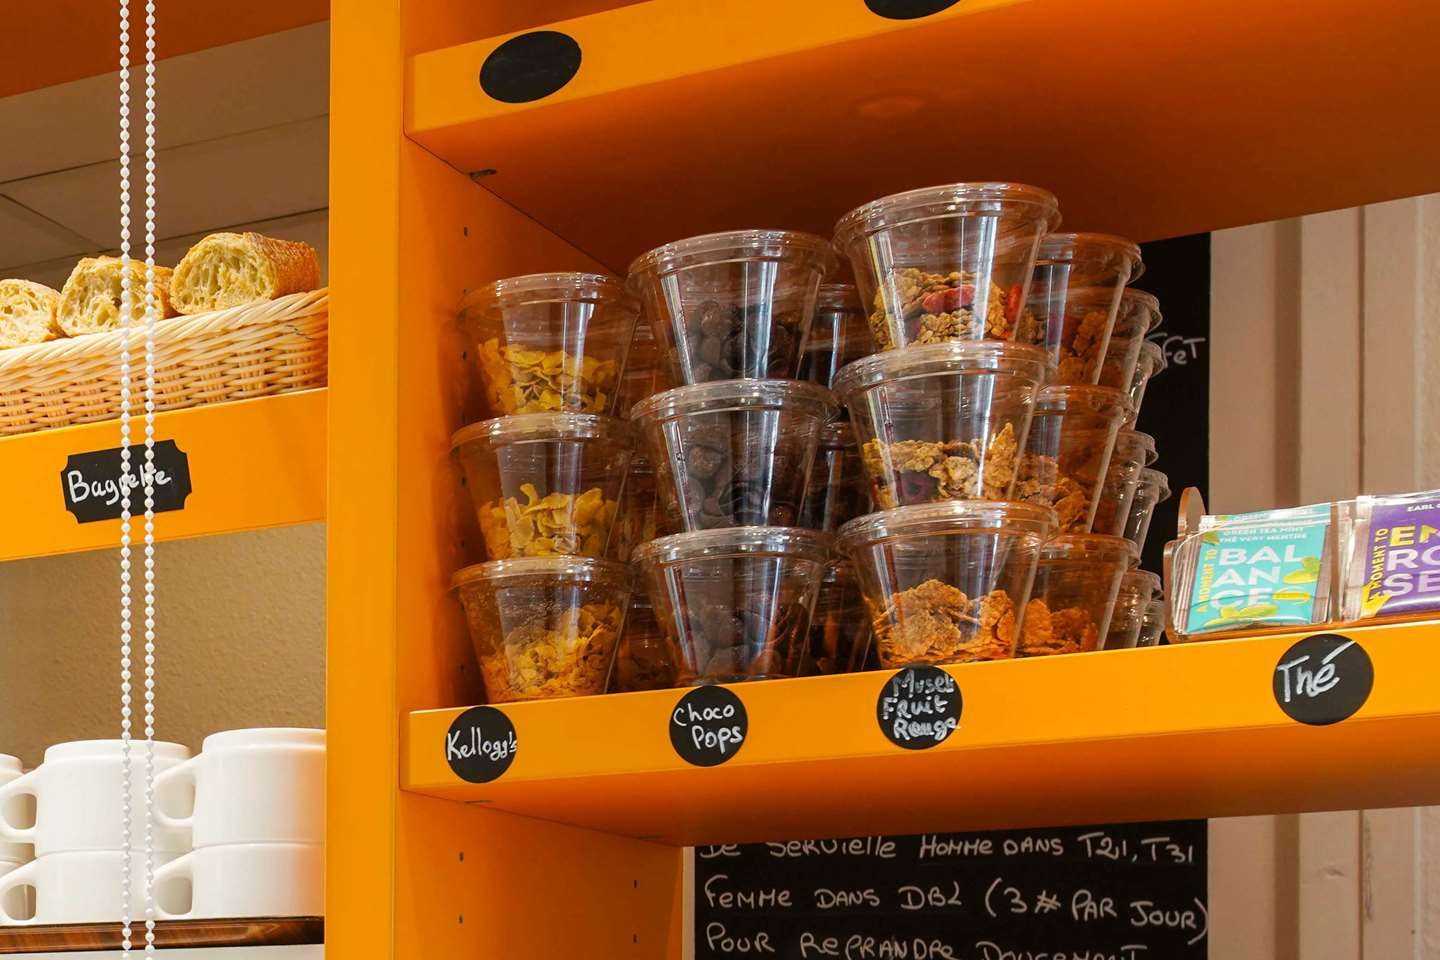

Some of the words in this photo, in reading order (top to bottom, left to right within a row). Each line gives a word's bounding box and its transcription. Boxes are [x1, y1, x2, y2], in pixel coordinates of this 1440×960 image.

[1219, 544, 1303, 566] BAL
[1210, 566, 1281, 588] AN
[1277, 640, 1356, 703] Thé
[673, 703, 734, 727] Choco
[447, 726, 518, 761] Kellogg's
[691, 724, 744, 754] Pops
[1003, 837, 1064, 856] DANS
[1141, 836, 1194, 864] T31
[814, 888, 881, 909] DANS
[1071, 889, 1118, 921] PAR
[706, 922, 776, 953] POUR
